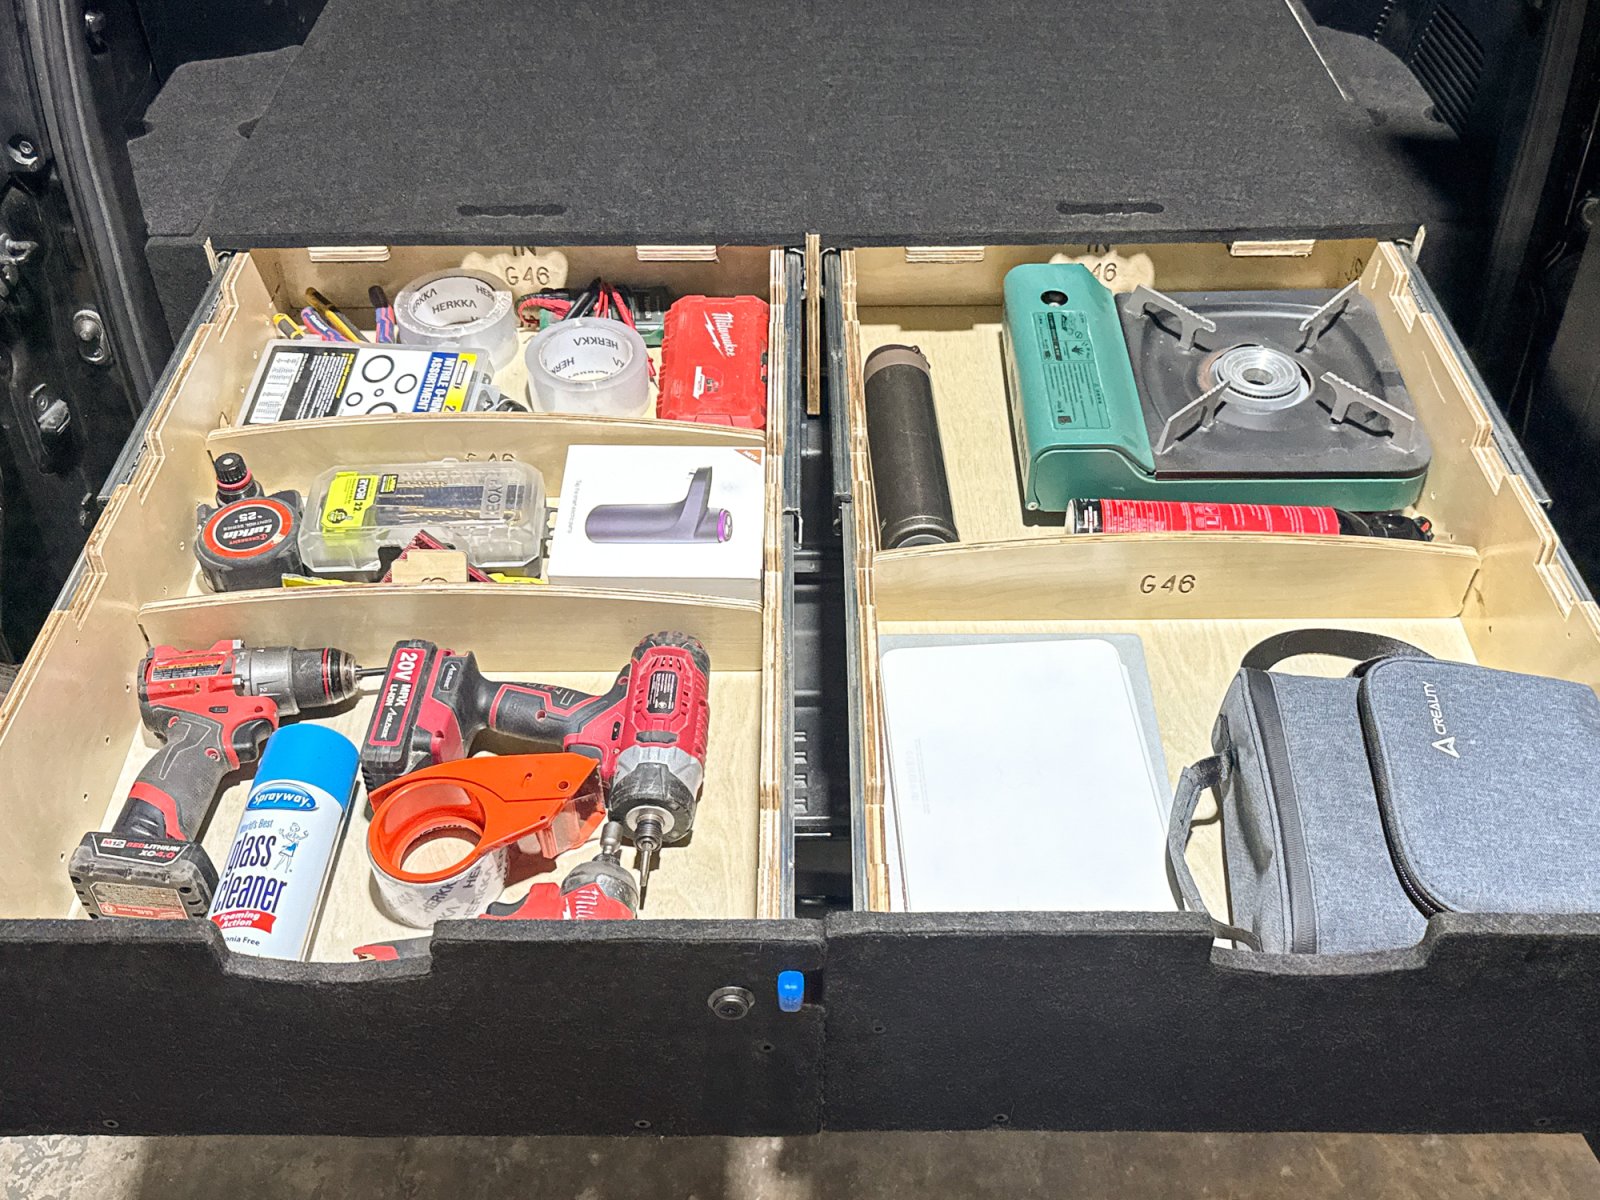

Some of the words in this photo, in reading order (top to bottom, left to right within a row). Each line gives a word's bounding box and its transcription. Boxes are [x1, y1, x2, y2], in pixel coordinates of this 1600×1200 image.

[505, 266, 550, 286] G46
[1092, 262, 1117, 282] 46
[431, 299, 477, 314] HERKKA
[573, 336, 618, 350] HERKKA
[711, 311, 738, 358] Milwaukee
[437, 357, 457, 388] NITRILE
[416, 357, 443, 411] ASSORTMENT
[429, 389, 447, 412] O-RIN
[355, 479, 369, 500] RYOBI
[354, 502, 363, 511] 22
[222, 524, 273, 539] Lufkin
[223, 523, 245, 532] SERIES
[1140, 574, 1196, 594] G46
[395, 651, 418, 680] 20V
[1422, 681, 1447, 735] CREALITY
[253, 792, 310, 808] Sprayway
[258, 819, 274, 829] Best
[102, 839, 125, 848] M12
[226, 832, 277, 878] glass
[213, 872, 288, 914] cleaner
[423, 881, 457, 913] HERKK
[219, 910, 261, 921] Foaming
[221, 918, 253, 929] Action
[225, 935, 241, 944] onia
[242, 936, 261, 947] Free
